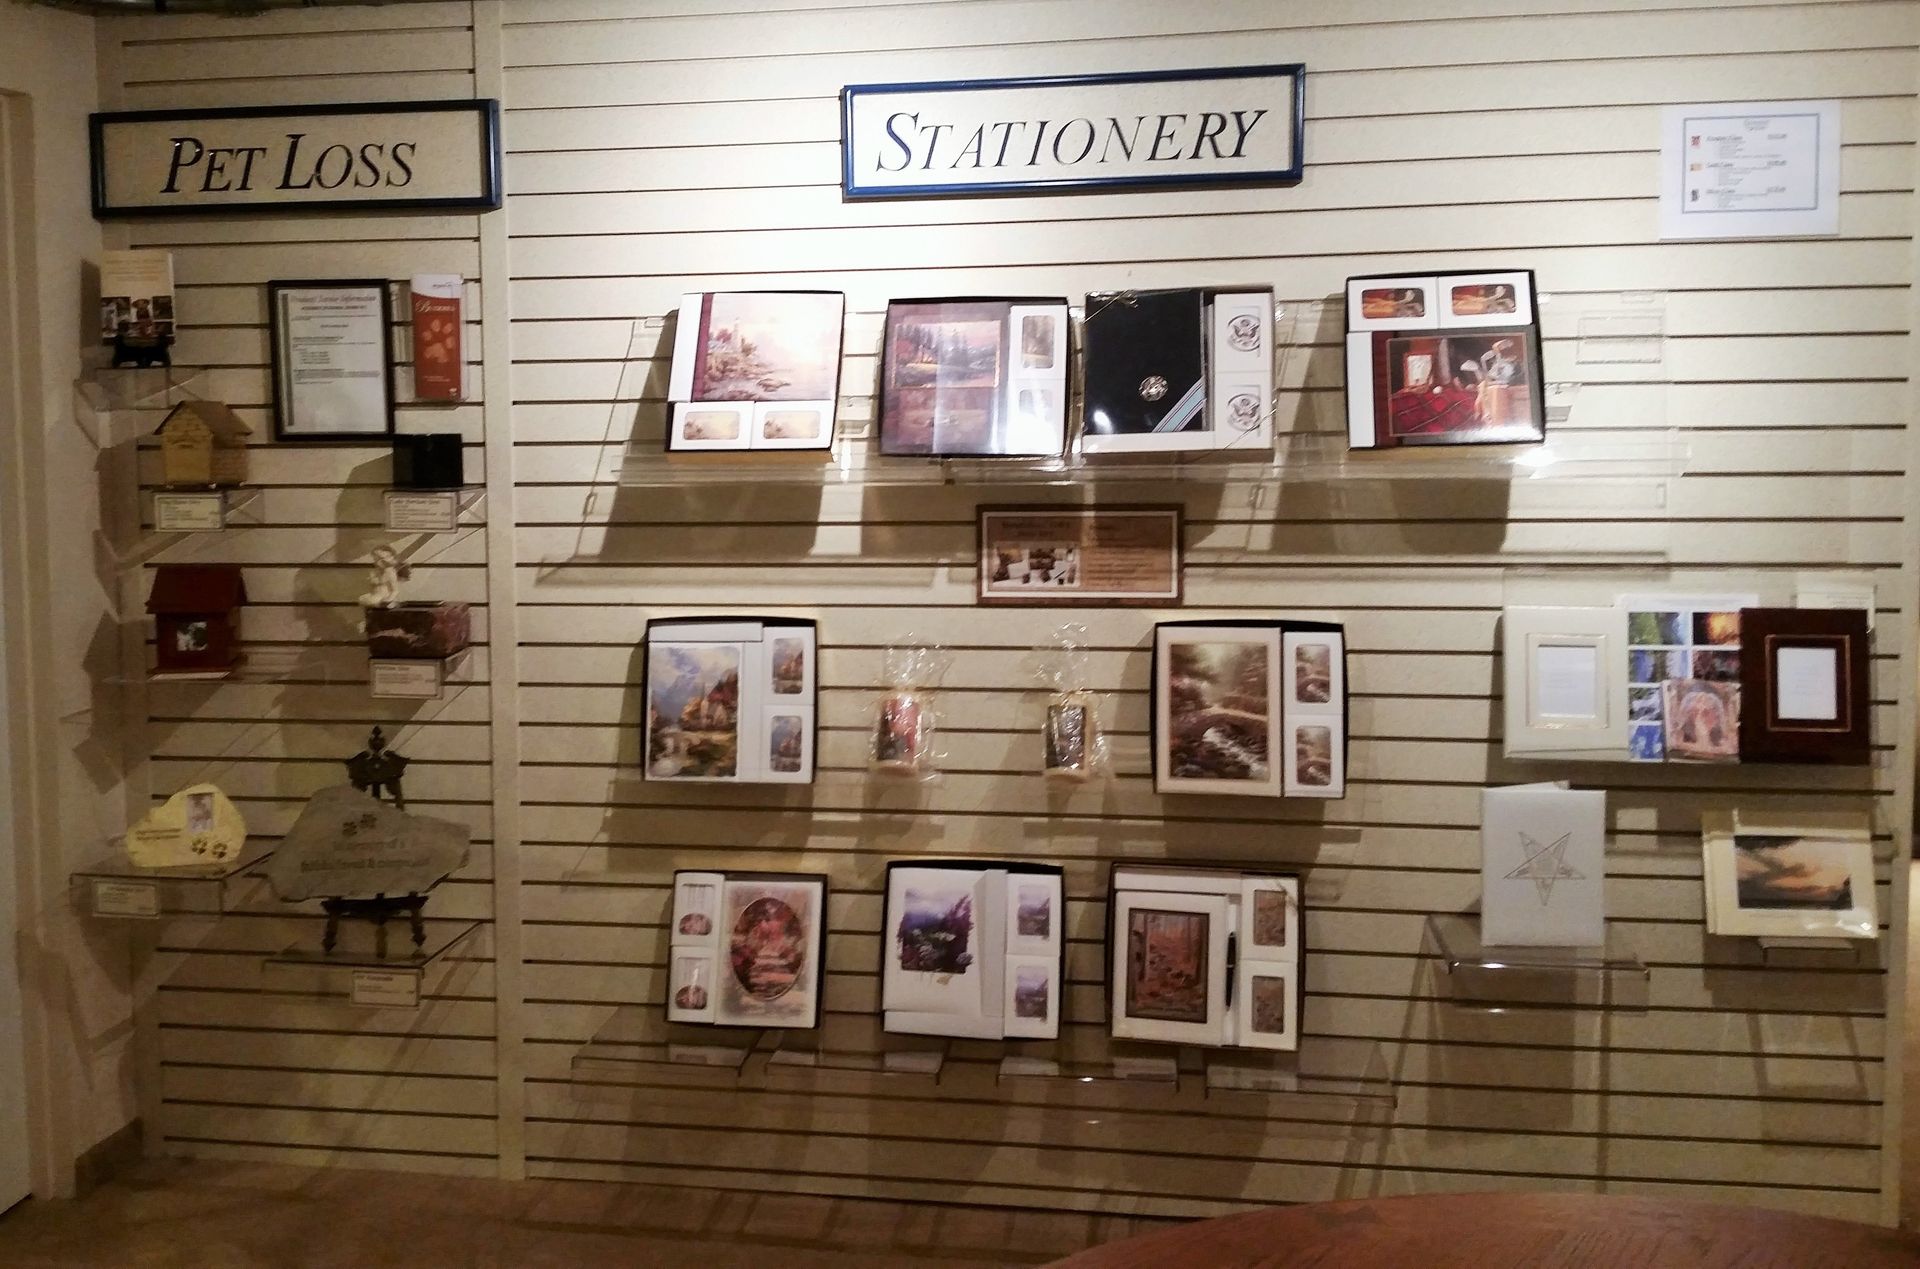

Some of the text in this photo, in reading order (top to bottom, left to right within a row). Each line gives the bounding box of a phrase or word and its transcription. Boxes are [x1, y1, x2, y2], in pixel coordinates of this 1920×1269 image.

[160, 133, 416, 193] PET LOSS
[876, 109, 1268, 173] STATIONERY
